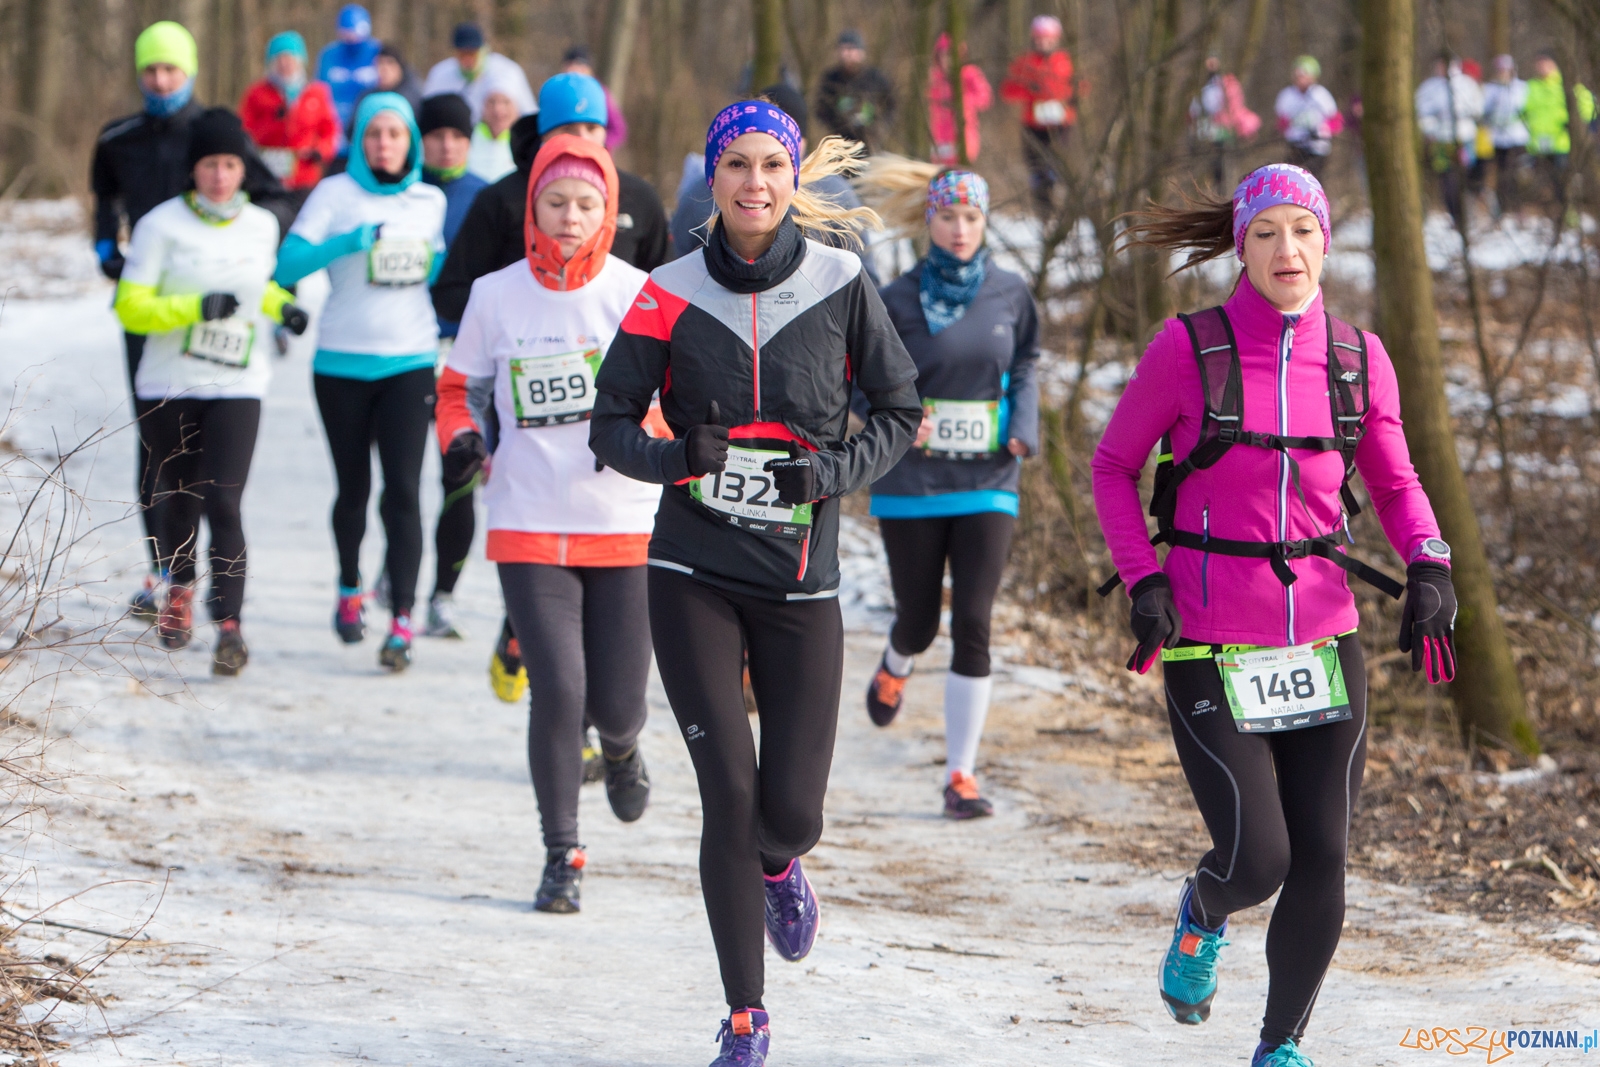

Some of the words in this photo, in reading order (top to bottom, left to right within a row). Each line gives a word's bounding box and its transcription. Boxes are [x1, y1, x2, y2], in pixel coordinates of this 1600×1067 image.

[1340, 371, 1358, 382] 4F
[529, 373, 587, 404] 859
[938, 418, 984, 441] 650
[1250, 668, 1320, 705] 148
[1270, 703, 1306, 715] NATALIA
